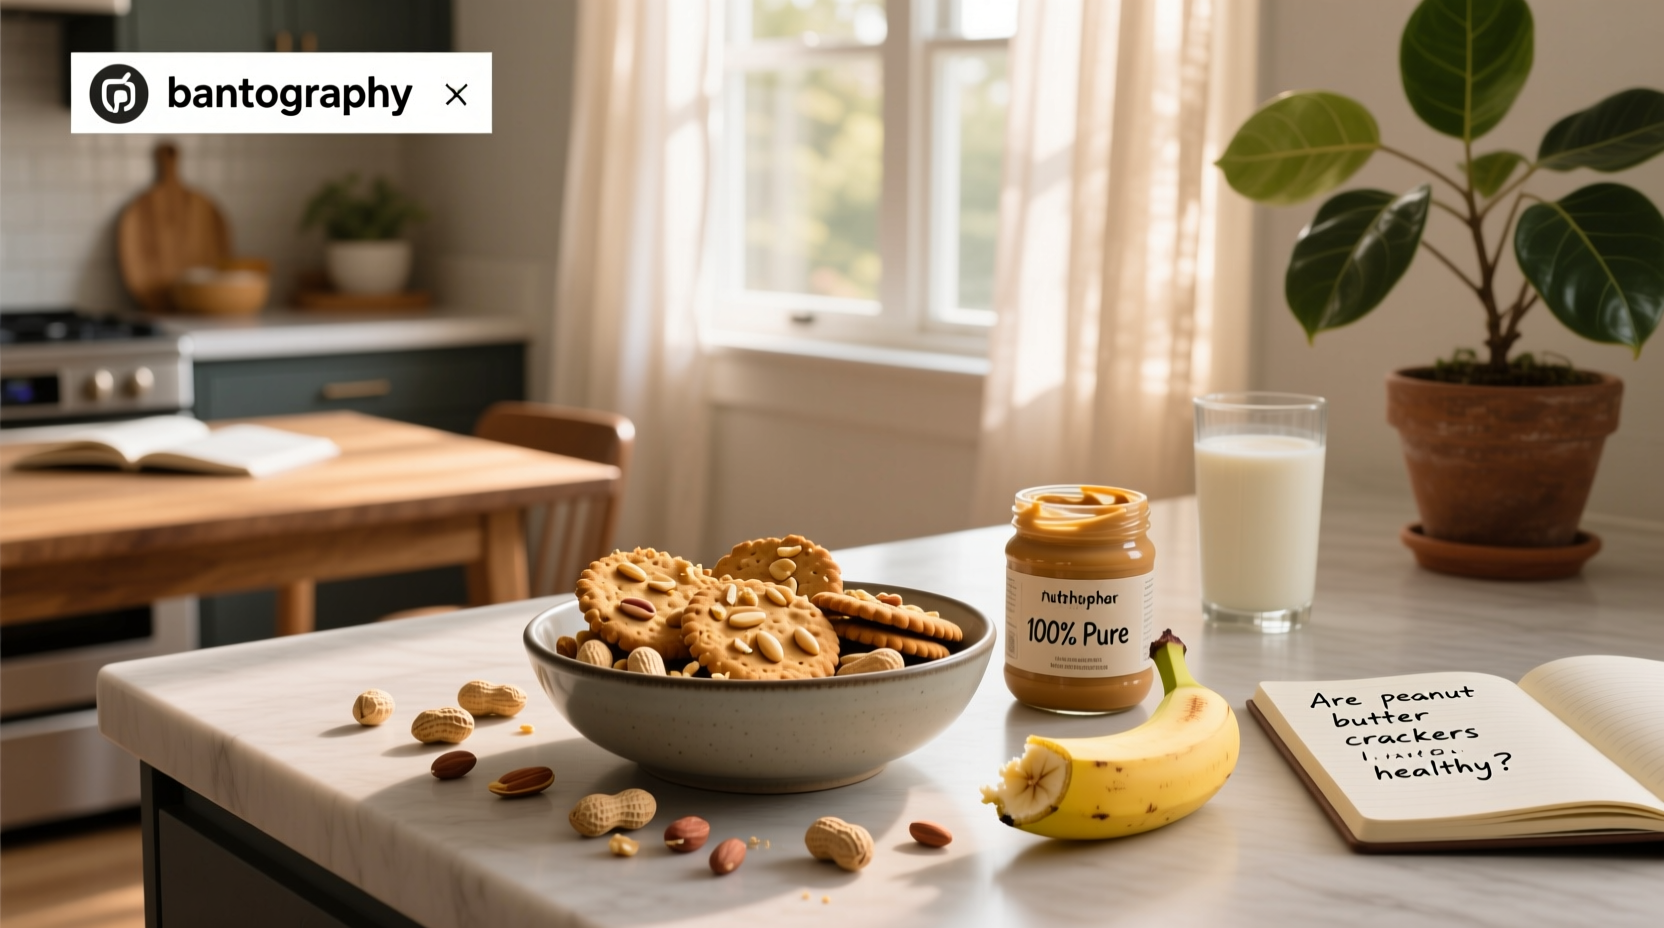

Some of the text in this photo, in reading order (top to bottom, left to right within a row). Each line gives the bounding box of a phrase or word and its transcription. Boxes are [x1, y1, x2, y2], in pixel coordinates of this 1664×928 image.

[1027, 616, 1129, 646] 100% Pure
[1310, 685, 1475, 710] Are peanut
[1332, 710, 1429, 728] butter
[1345, 727, 1479, 746] crackers
[1374, 752, 1512, 781] healthy?
